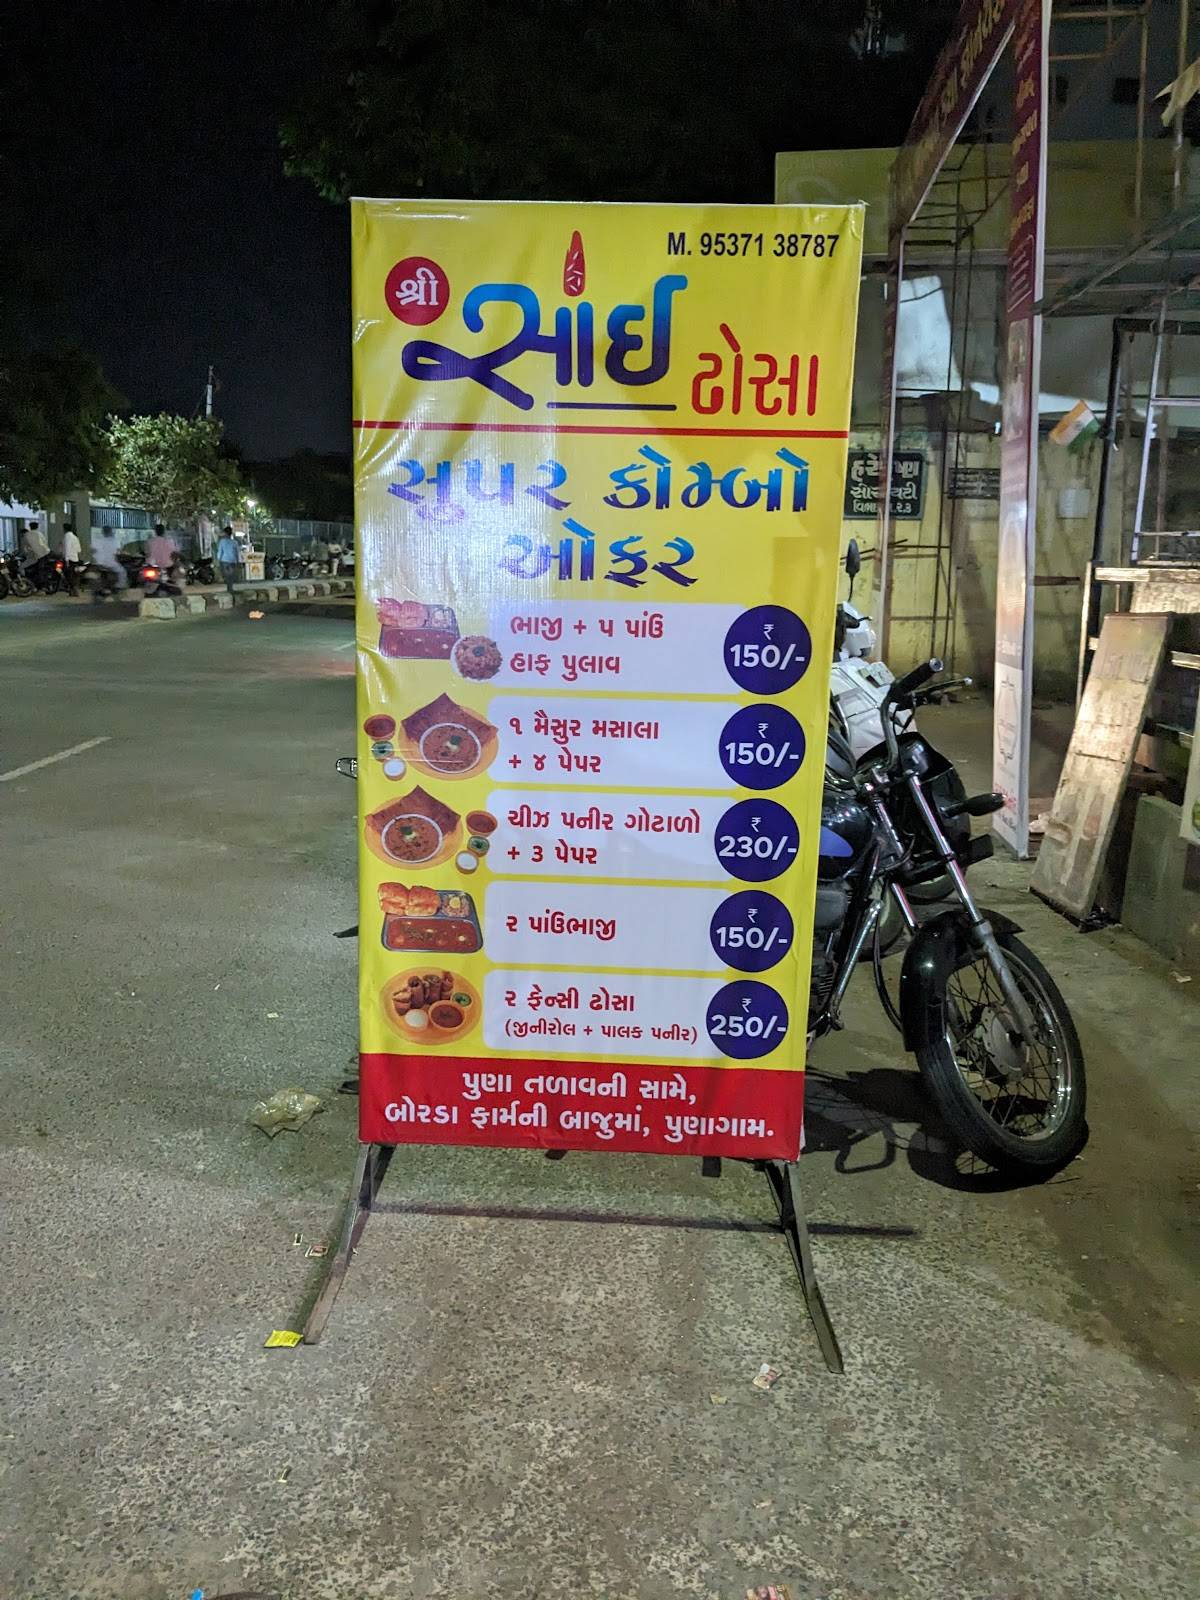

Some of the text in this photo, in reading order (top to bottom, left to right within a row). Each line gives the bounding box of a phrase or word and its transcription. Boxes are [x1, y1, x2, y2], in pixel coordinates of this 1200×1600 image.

[667, 231, 840, 258] M. 95371 38787
[396, 266, 440, 306] श्री
[691, 323, 819, 416] ઢોસા
[387, 444, 811, 526] સુપર કોમ્બો
[497, 517, 699, 589] ઓફર
[510, 616, 563, 641] ભાજી
[625, 610, 664, 639] પાંઉ
[509, 652, 621, 682] હાફ પુલાવ
[730, 643, 806, 671] 150/-
[534, 709, 582, 745] મૈસુર
[592, 719, 660, 740] મસાલા
[558, 746, 602, 773] પેપર
[725, 742, 800, 768] 150/-
[507, 804, 700, 834] ચીઝ પનીર ગોટાળો
[555, 838, 598, 865] પેપર
[718, 835, 797, 861] 230/-
[529, 909, 616, 941] પાંઉભાજી
[716, 926, 788, 951] 150/-
[527, 984, 579, 1011] ફેન્સી
[589, 986, 635, 1012] ઢોસા
[601, 1025, 643, 1039] પાલક
[651, 1023, 698, 1045] પનીર)
[710, 1014, 787, 1039] 250/-
[462, 1072, 697, 1105] પુણા તળાવની સામે,
[384, 1095, 775, 1143] બોરડા ફાર્મની બાજુમાં, પુણાગામ.
